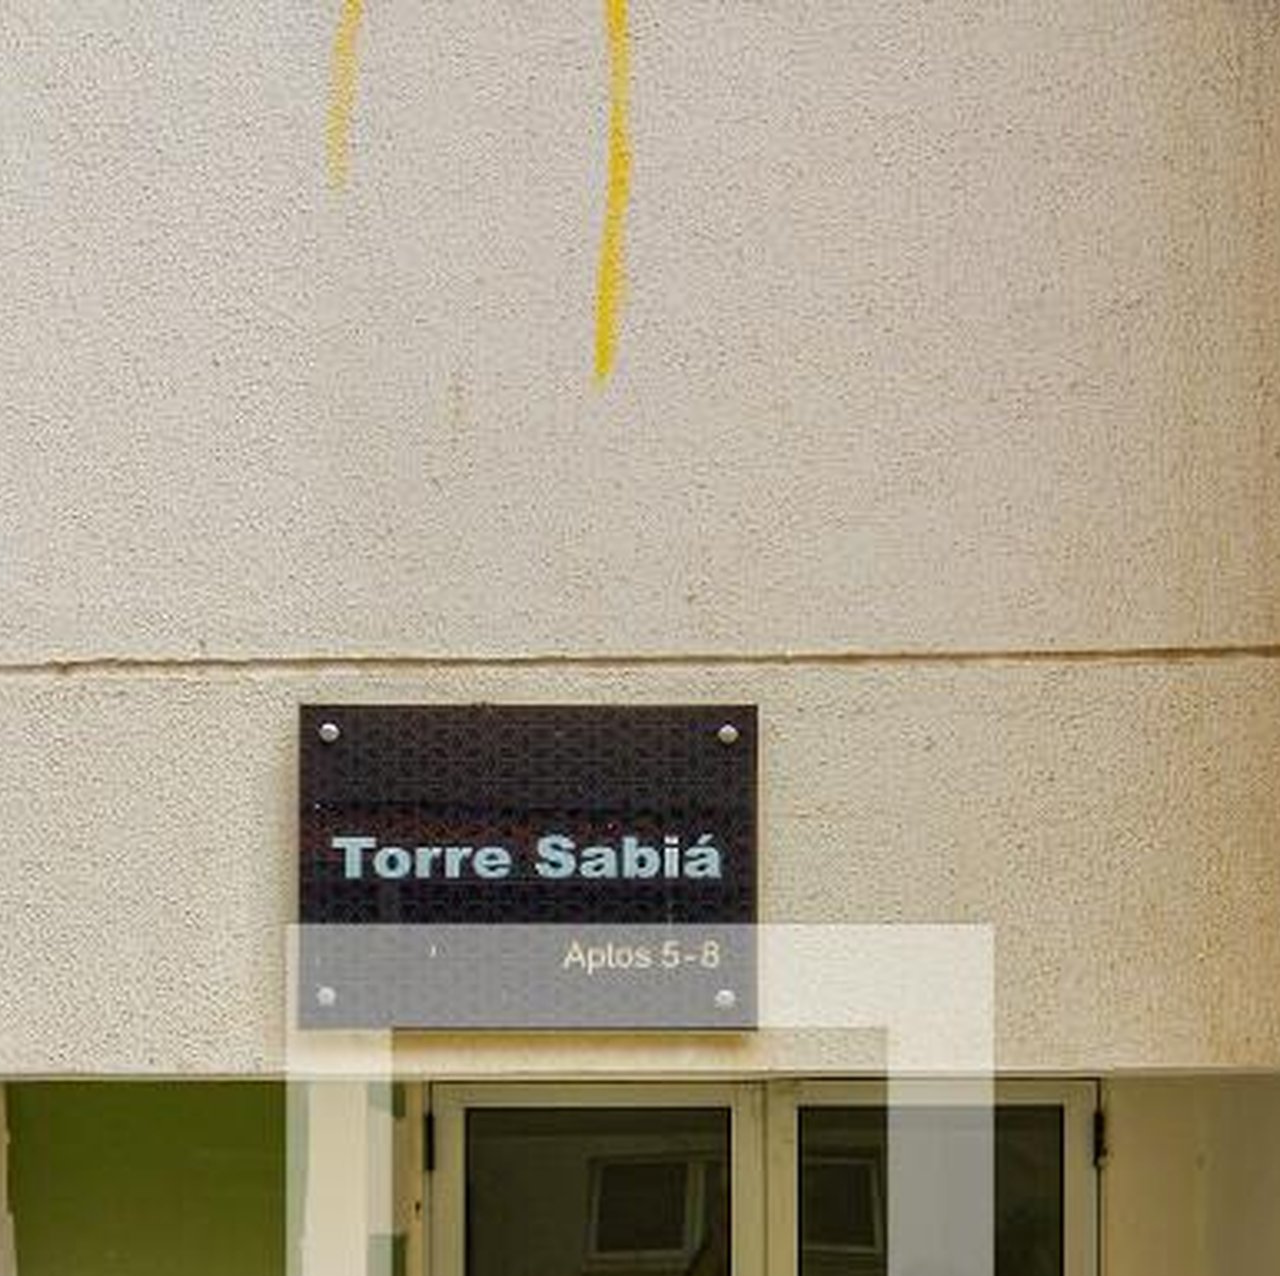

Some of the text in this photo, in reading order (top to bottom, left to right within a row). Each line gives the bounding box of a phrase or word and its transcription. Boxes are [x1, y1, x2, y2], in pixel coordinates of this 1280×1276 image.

[332, 833, 722, 879] Torre Sabiá
[563, 941, 652, 975] Aptos
